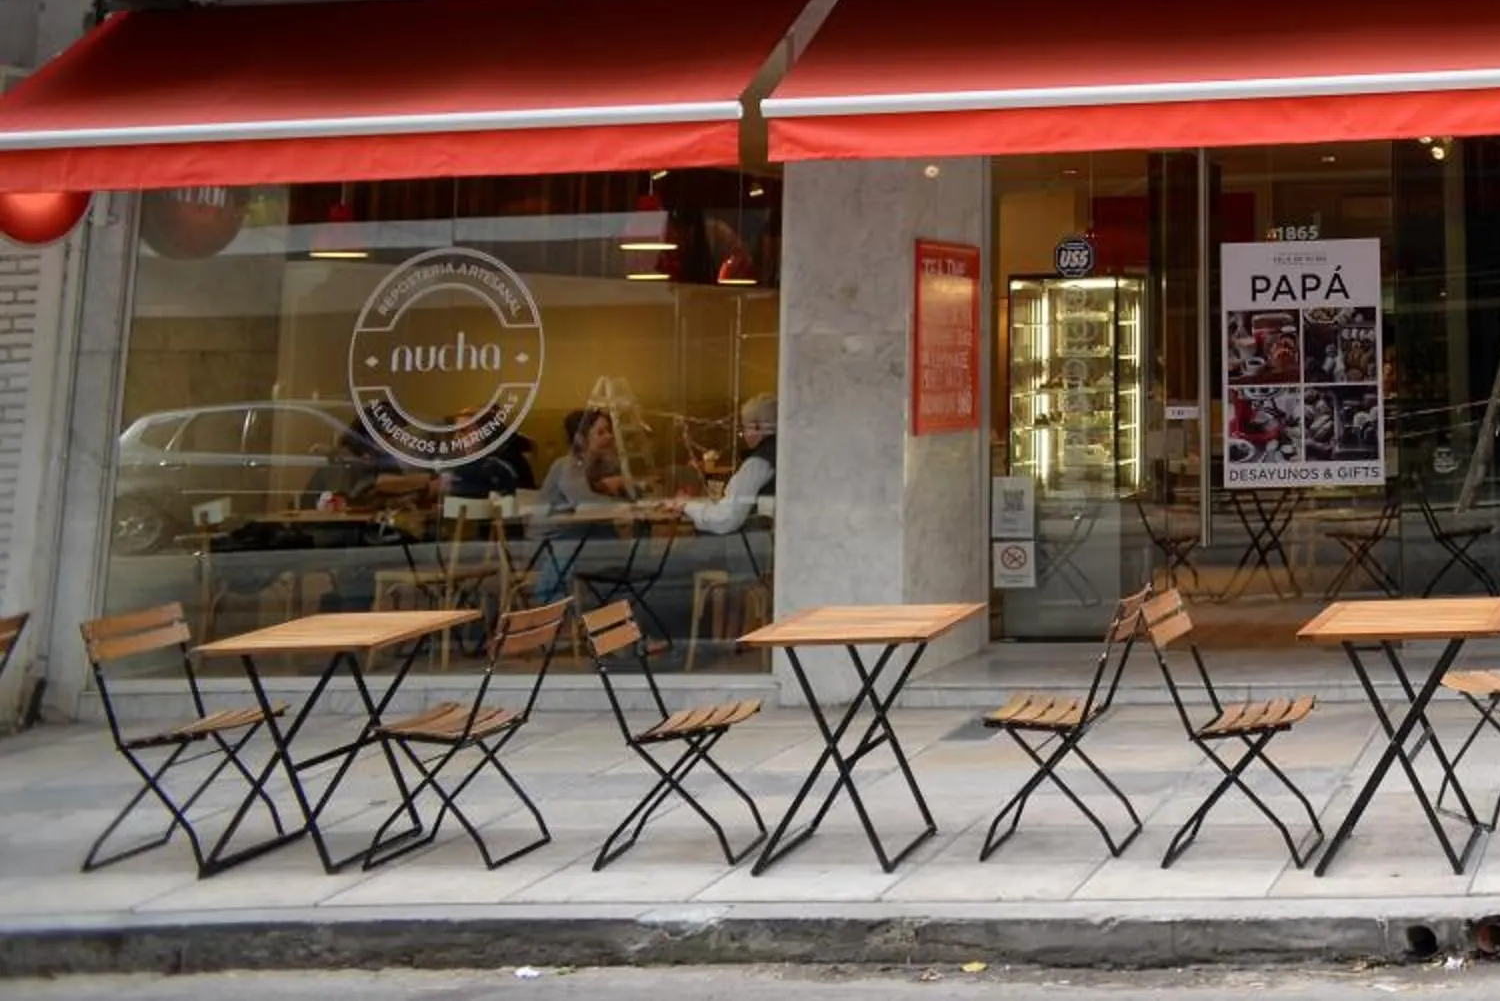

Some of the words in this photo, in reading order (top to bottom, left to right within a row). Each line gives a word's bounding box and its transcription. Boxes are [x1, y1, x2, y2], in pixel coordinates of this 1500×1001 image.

[1276, 225, 1320, 241] 1865
[1251, 265, 1350, 302] PAPÁ
[391, 331, 501, 372] nucha
[368, 399, 436, 454] ALMUERZOS
[438, 441, 449, 454] &
[451, 394, 518, 451] MERIENDAS
[1229, 468, 1319, 482] DESAYUNOS
[1323, 469, 1333, 479] &
[1337, 466, 1380, 480] GIFTS
